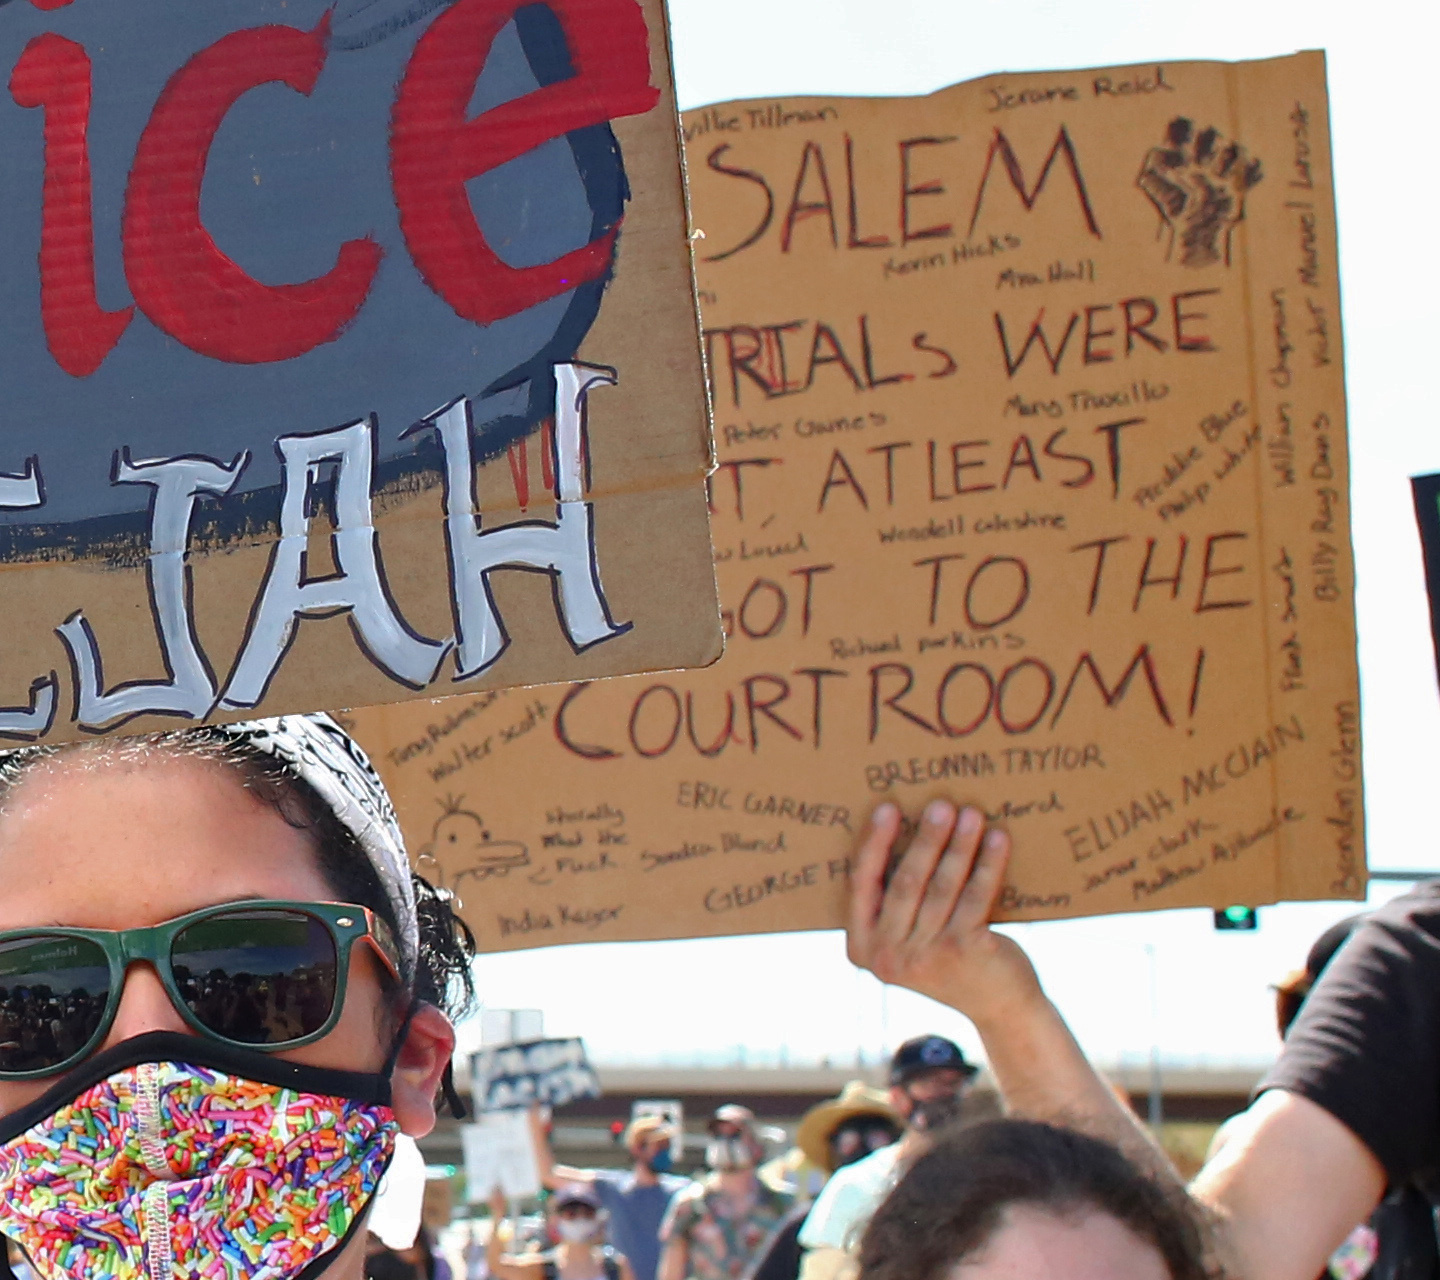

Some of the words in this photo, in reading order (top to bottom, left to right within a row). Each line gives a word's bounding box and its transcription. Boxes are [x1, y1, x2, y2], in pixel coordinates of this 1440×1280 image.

[700, 124, 1102, 264] SALEM
[702, 315, 958, 411] TRIALS
[994, 286, 1223, 379] WERE
[913, 552, 1031, 630] TO
[1070, 531, 1254, 616] THE
[676, 781, 733, 811] ERIC
[743, 791, 853, 830] GARNER
[1062, 789, 1175, 864] ELIJAH
[704, 864, 820, 915] GEORGE
